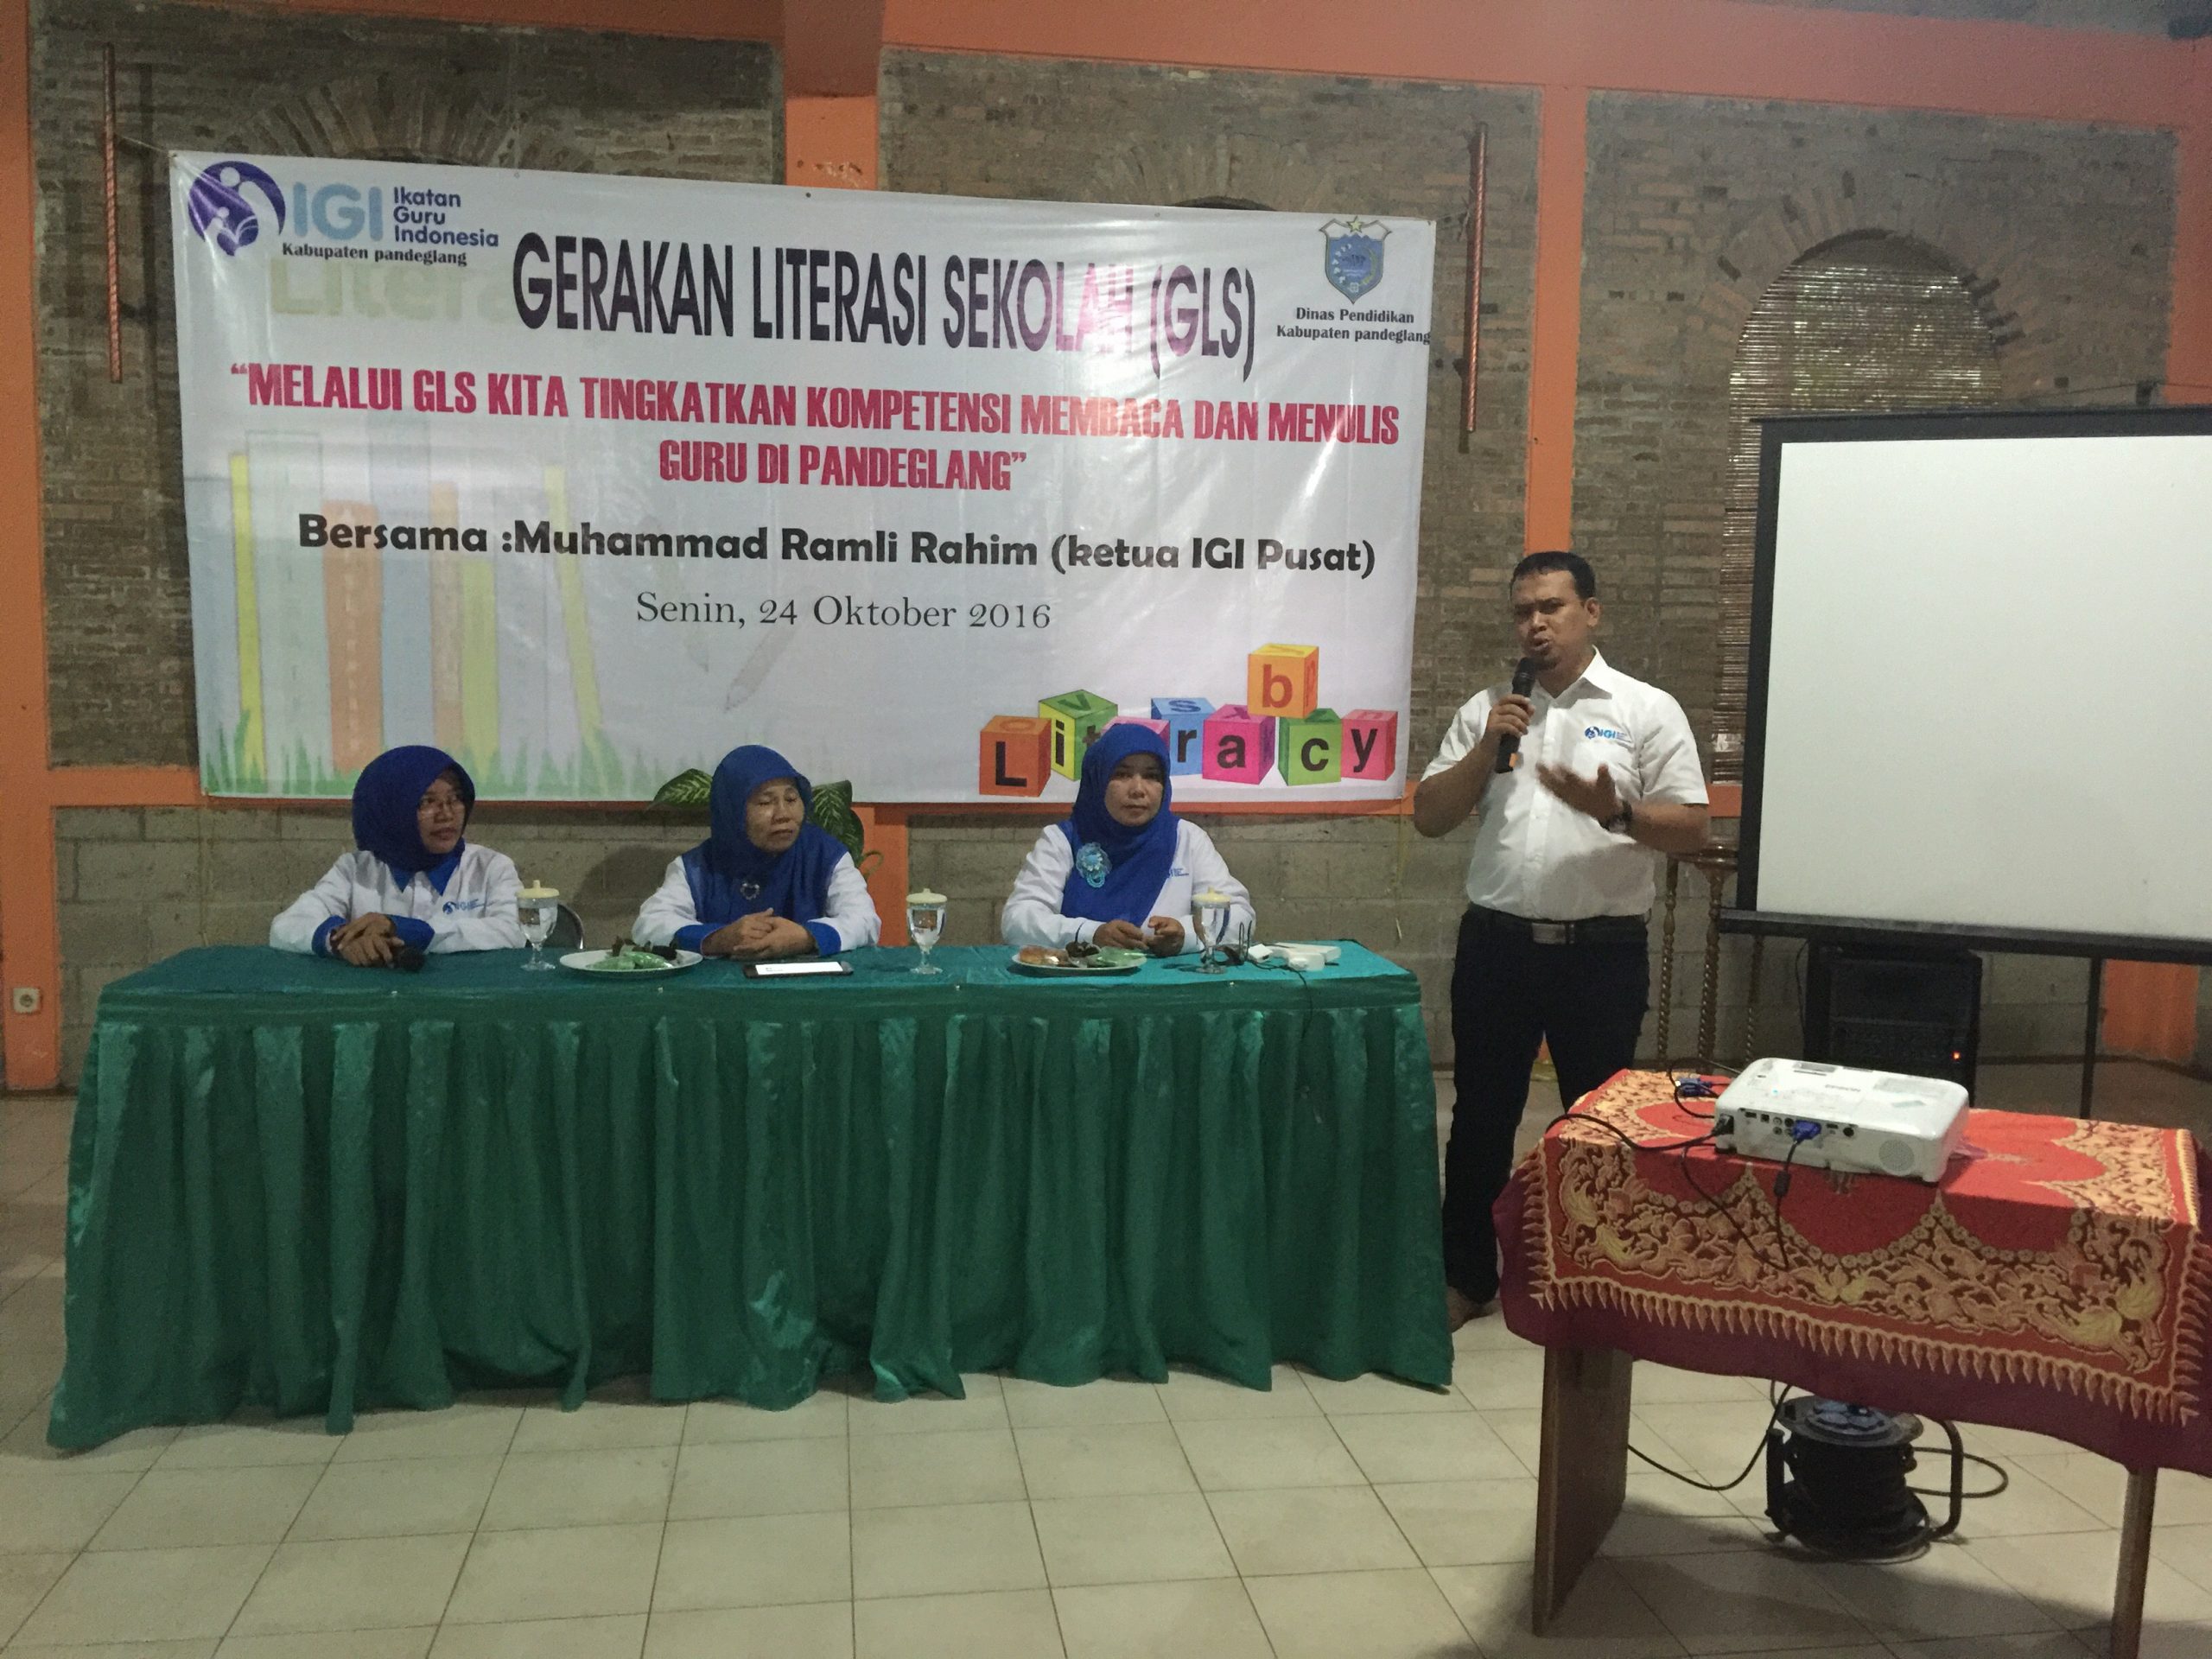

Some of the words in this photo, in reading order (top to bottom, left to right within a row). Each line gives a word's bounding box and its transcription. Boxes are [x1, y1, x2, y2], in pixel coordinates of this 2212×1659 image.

[293, 181, 384, 241] IGI
[393, 187, 461, 207] Ikatan
[393, 206, 446, 225] Guru
[394, 226, 499, 247] Indonesia
[282, 243, 368, 260] Kabupaten
[374, 250, 467, 267] pandeglang
[512, 232, 734, 337] GERAKAN
[753, 245, 926, 346] LITERASI
[943, 254, 1135, 353] SEKOLAH
[1150, 264, 1256, 384] (GLS)
[1296, 307, 1335, 321] Dinas
[1340, 308, 1414, 323] Pendidikan
[1277, 325, 1350, 340] Kabupaten
[1355, 328, 1432, 345] pandeglang
[414, 370, 475, 415] GLS
[488, 373, 569, 417] KITA
[580, 377, 797, 427] TINGKATKAN
[806, 387, 1011, 434] KOMPETENSI
[1021, 395, 1184, 440] MEMBACA
[1194, 400, 1259, 441] DAN
[1268, 403, 1400, 445] MENULIS
[659, 439, 747, 484] GURU
[758, 442, 786, 486] DI
[298, 513, 487, 553] Bersama
[780, 528, 899, 563] Ramli
[911, 531, 1038, 567] Rahim
[1051, 534, 1179, 574] (ketua
[1192, 537, 1244, 570] IGI
[1257, 537, 1376, 580] Pusat)
[637, 592, 746, 628] Senin,
[759, 600, 798, 626] 24
[813, 594, 957, 628] Oktober
[969, 603, 1052, 629] 2016
